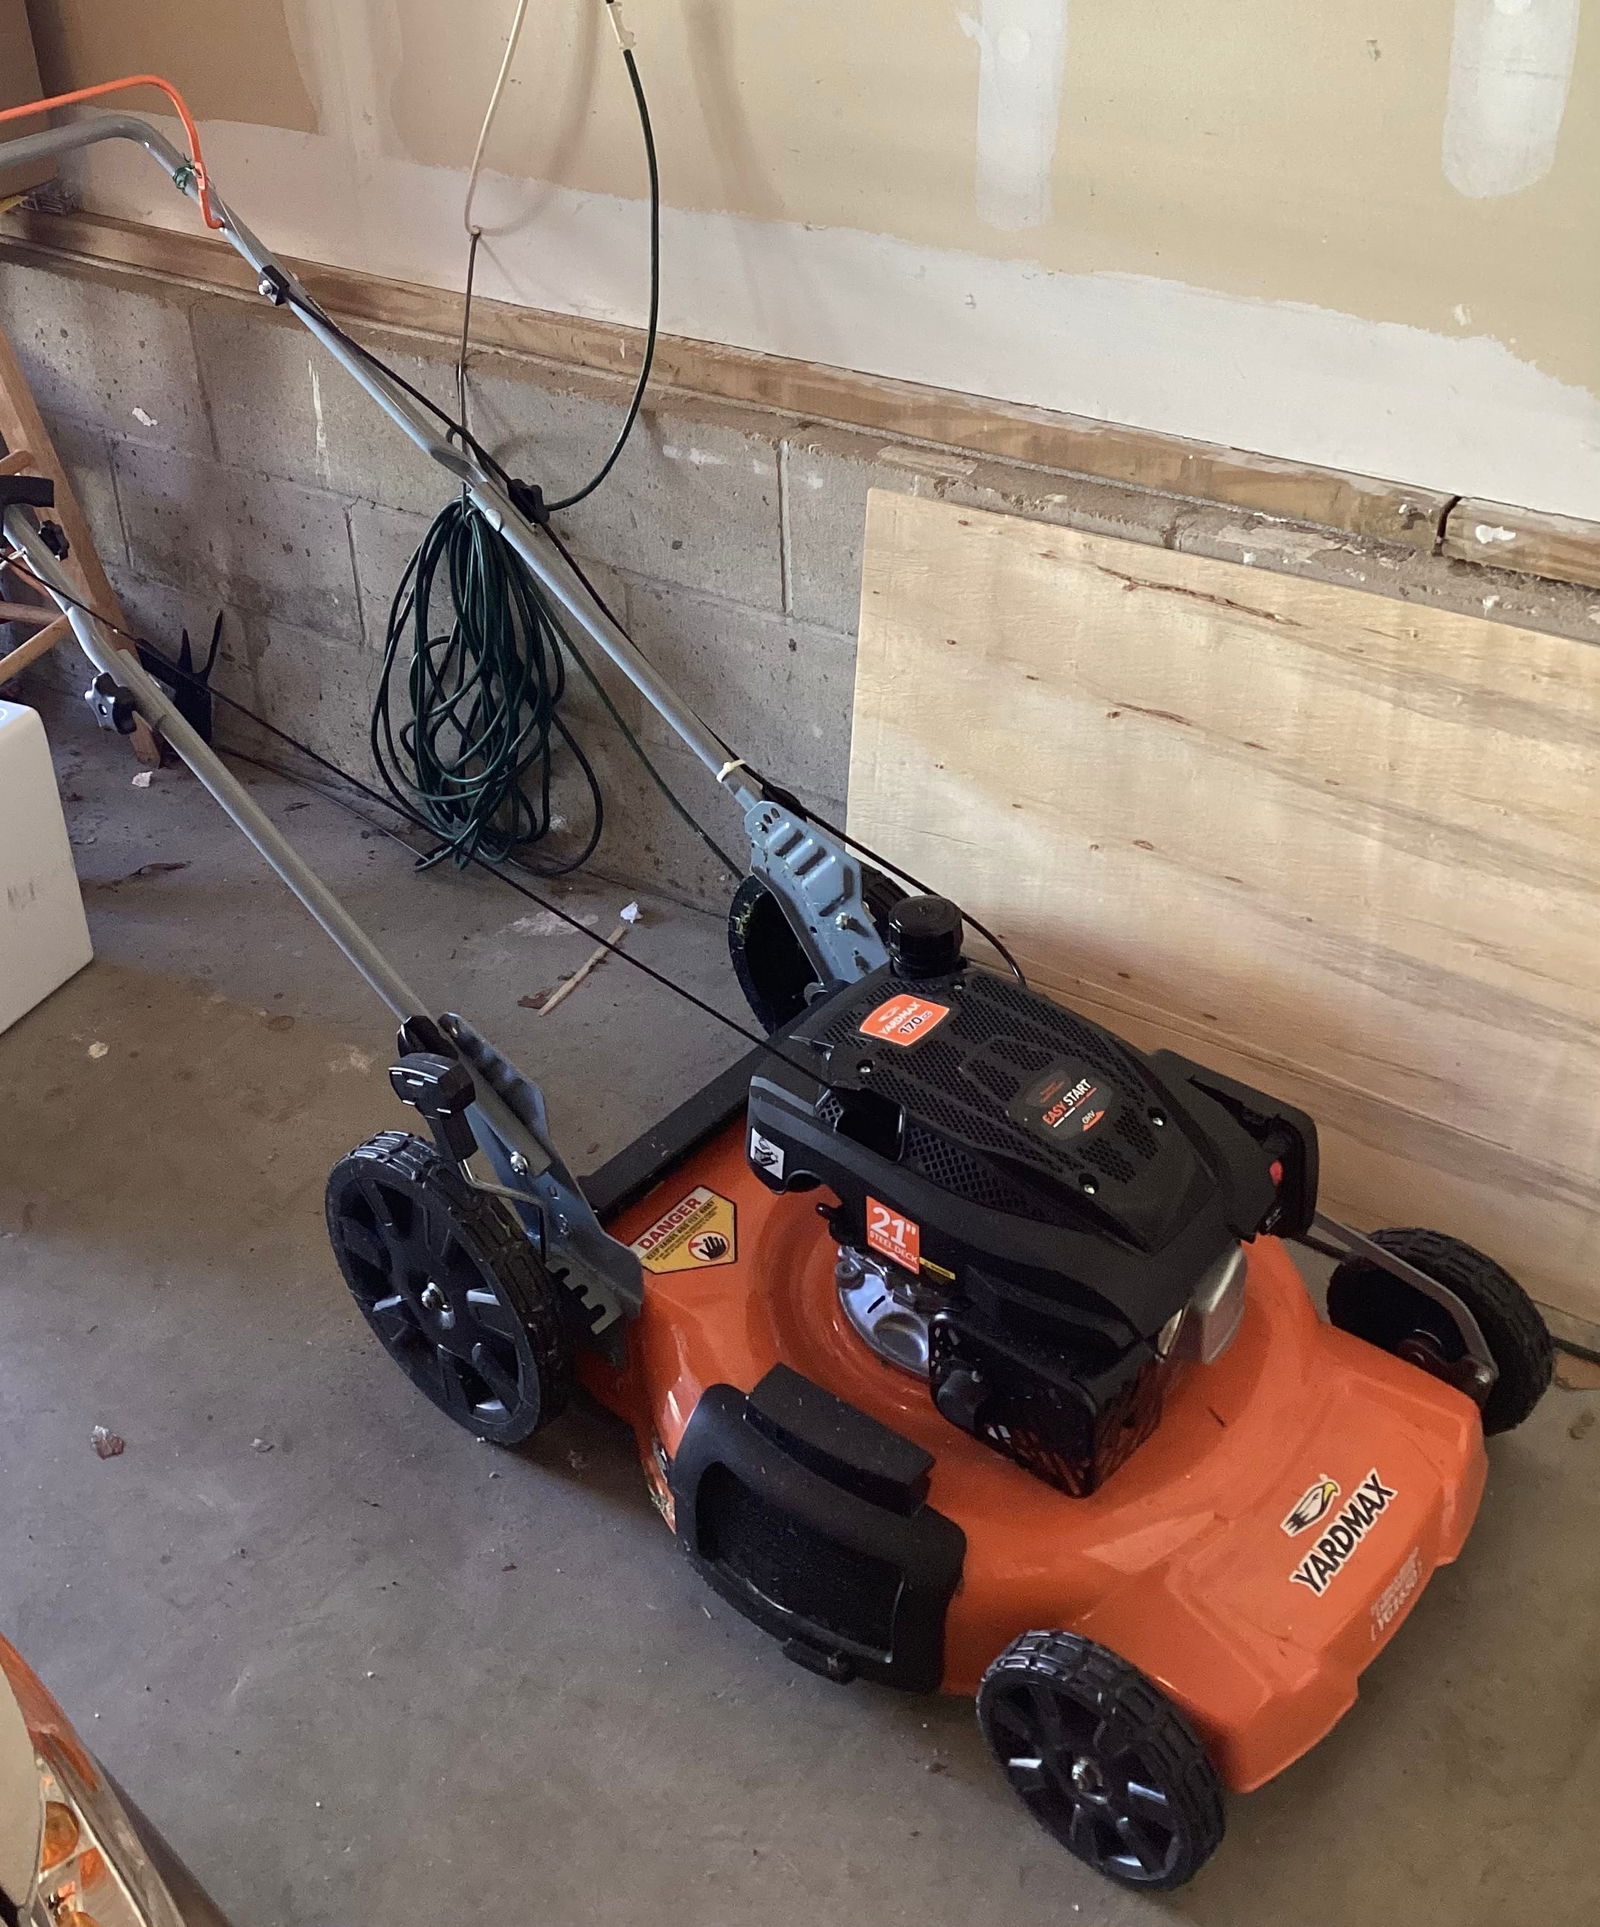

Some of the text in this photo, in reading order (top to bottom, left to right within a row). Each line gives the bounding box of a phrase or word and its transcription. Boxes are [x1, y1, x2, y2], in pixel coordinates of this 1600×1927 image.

[879, 1001, 921, 1036] YARDMAX
[1042, 1101, 1067, 1126] EASY
[1063, 1078, 1091, 1107] START
[638, 1198, 701, 1250] DANGER
[871, 1207, 916, 1248] 21"
[869, 1231, 918, 1264] STEEL DECK
[1292, 1470, 1396, 1595] YARDMAX
